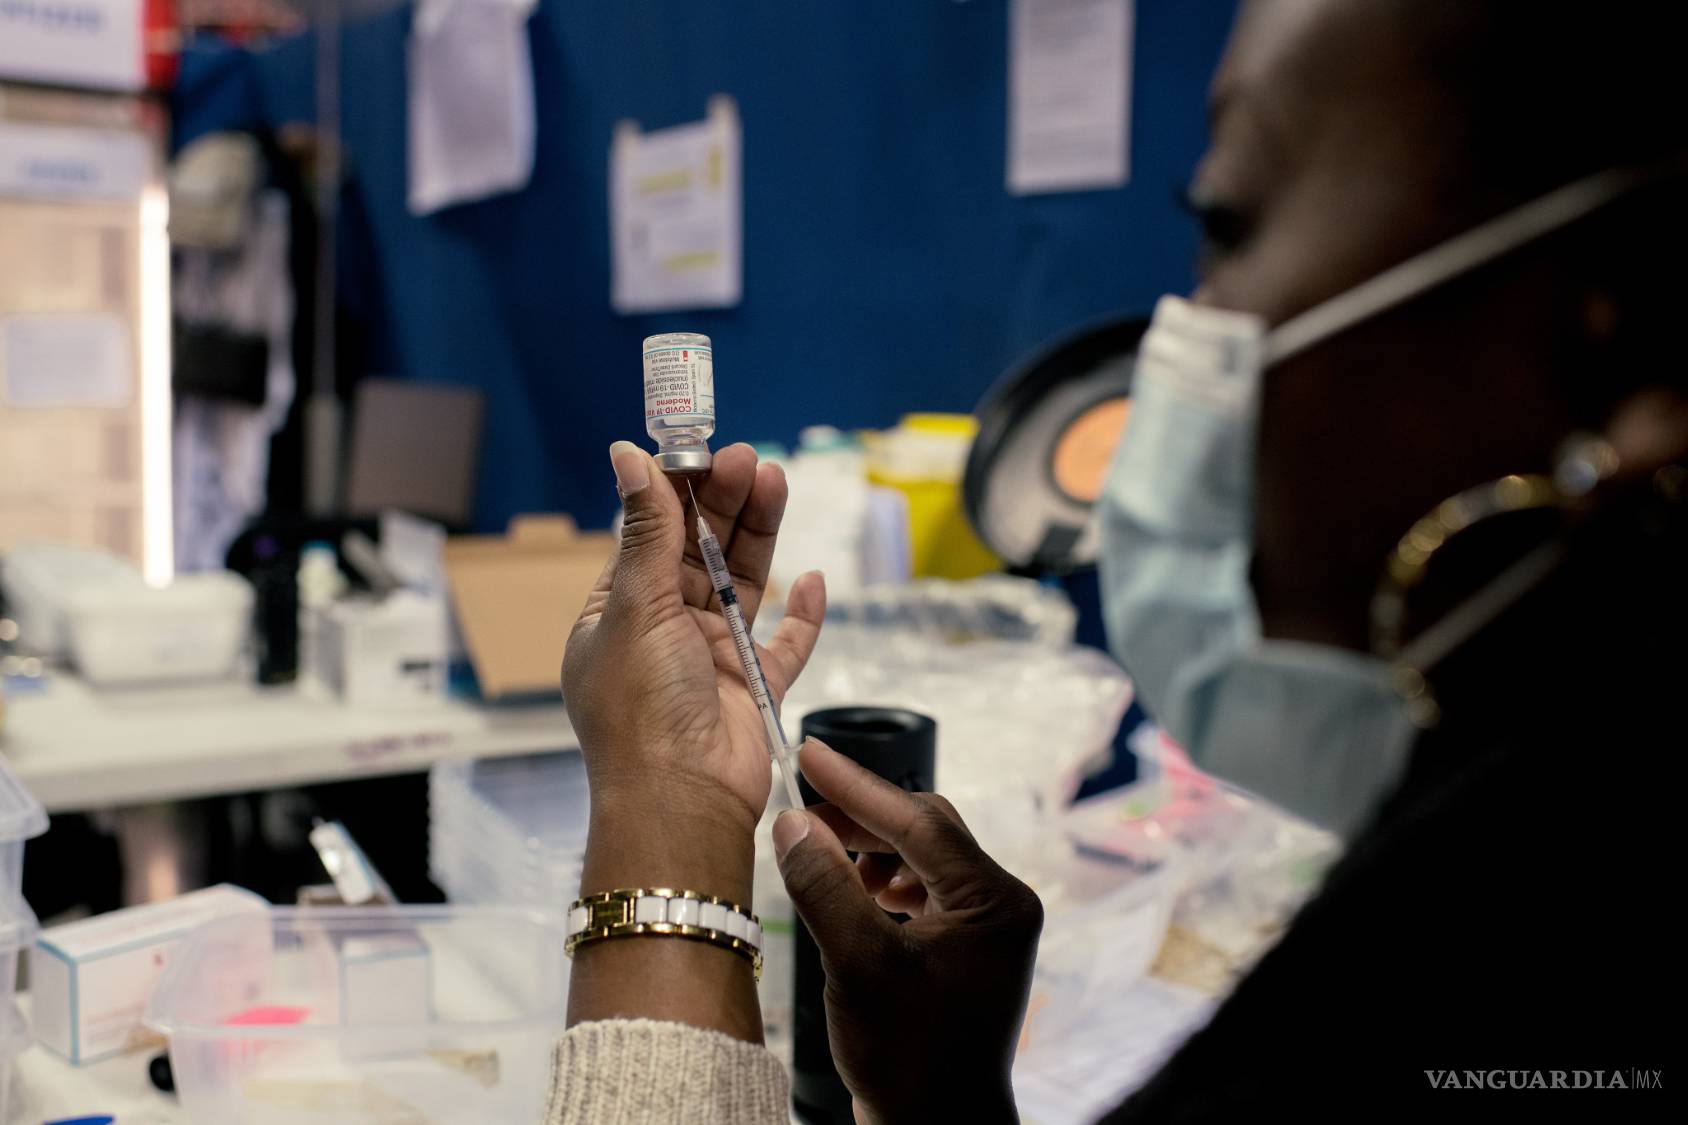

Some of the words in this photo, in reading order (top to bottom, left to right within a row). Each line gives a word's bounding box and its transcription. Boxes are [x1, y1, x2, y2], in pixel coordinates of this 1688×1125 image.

[660, 383, 688, 392] COVID-19
[656, 398, 691, 406] Moderna
[657, 406, 692, 415] COVID-19
